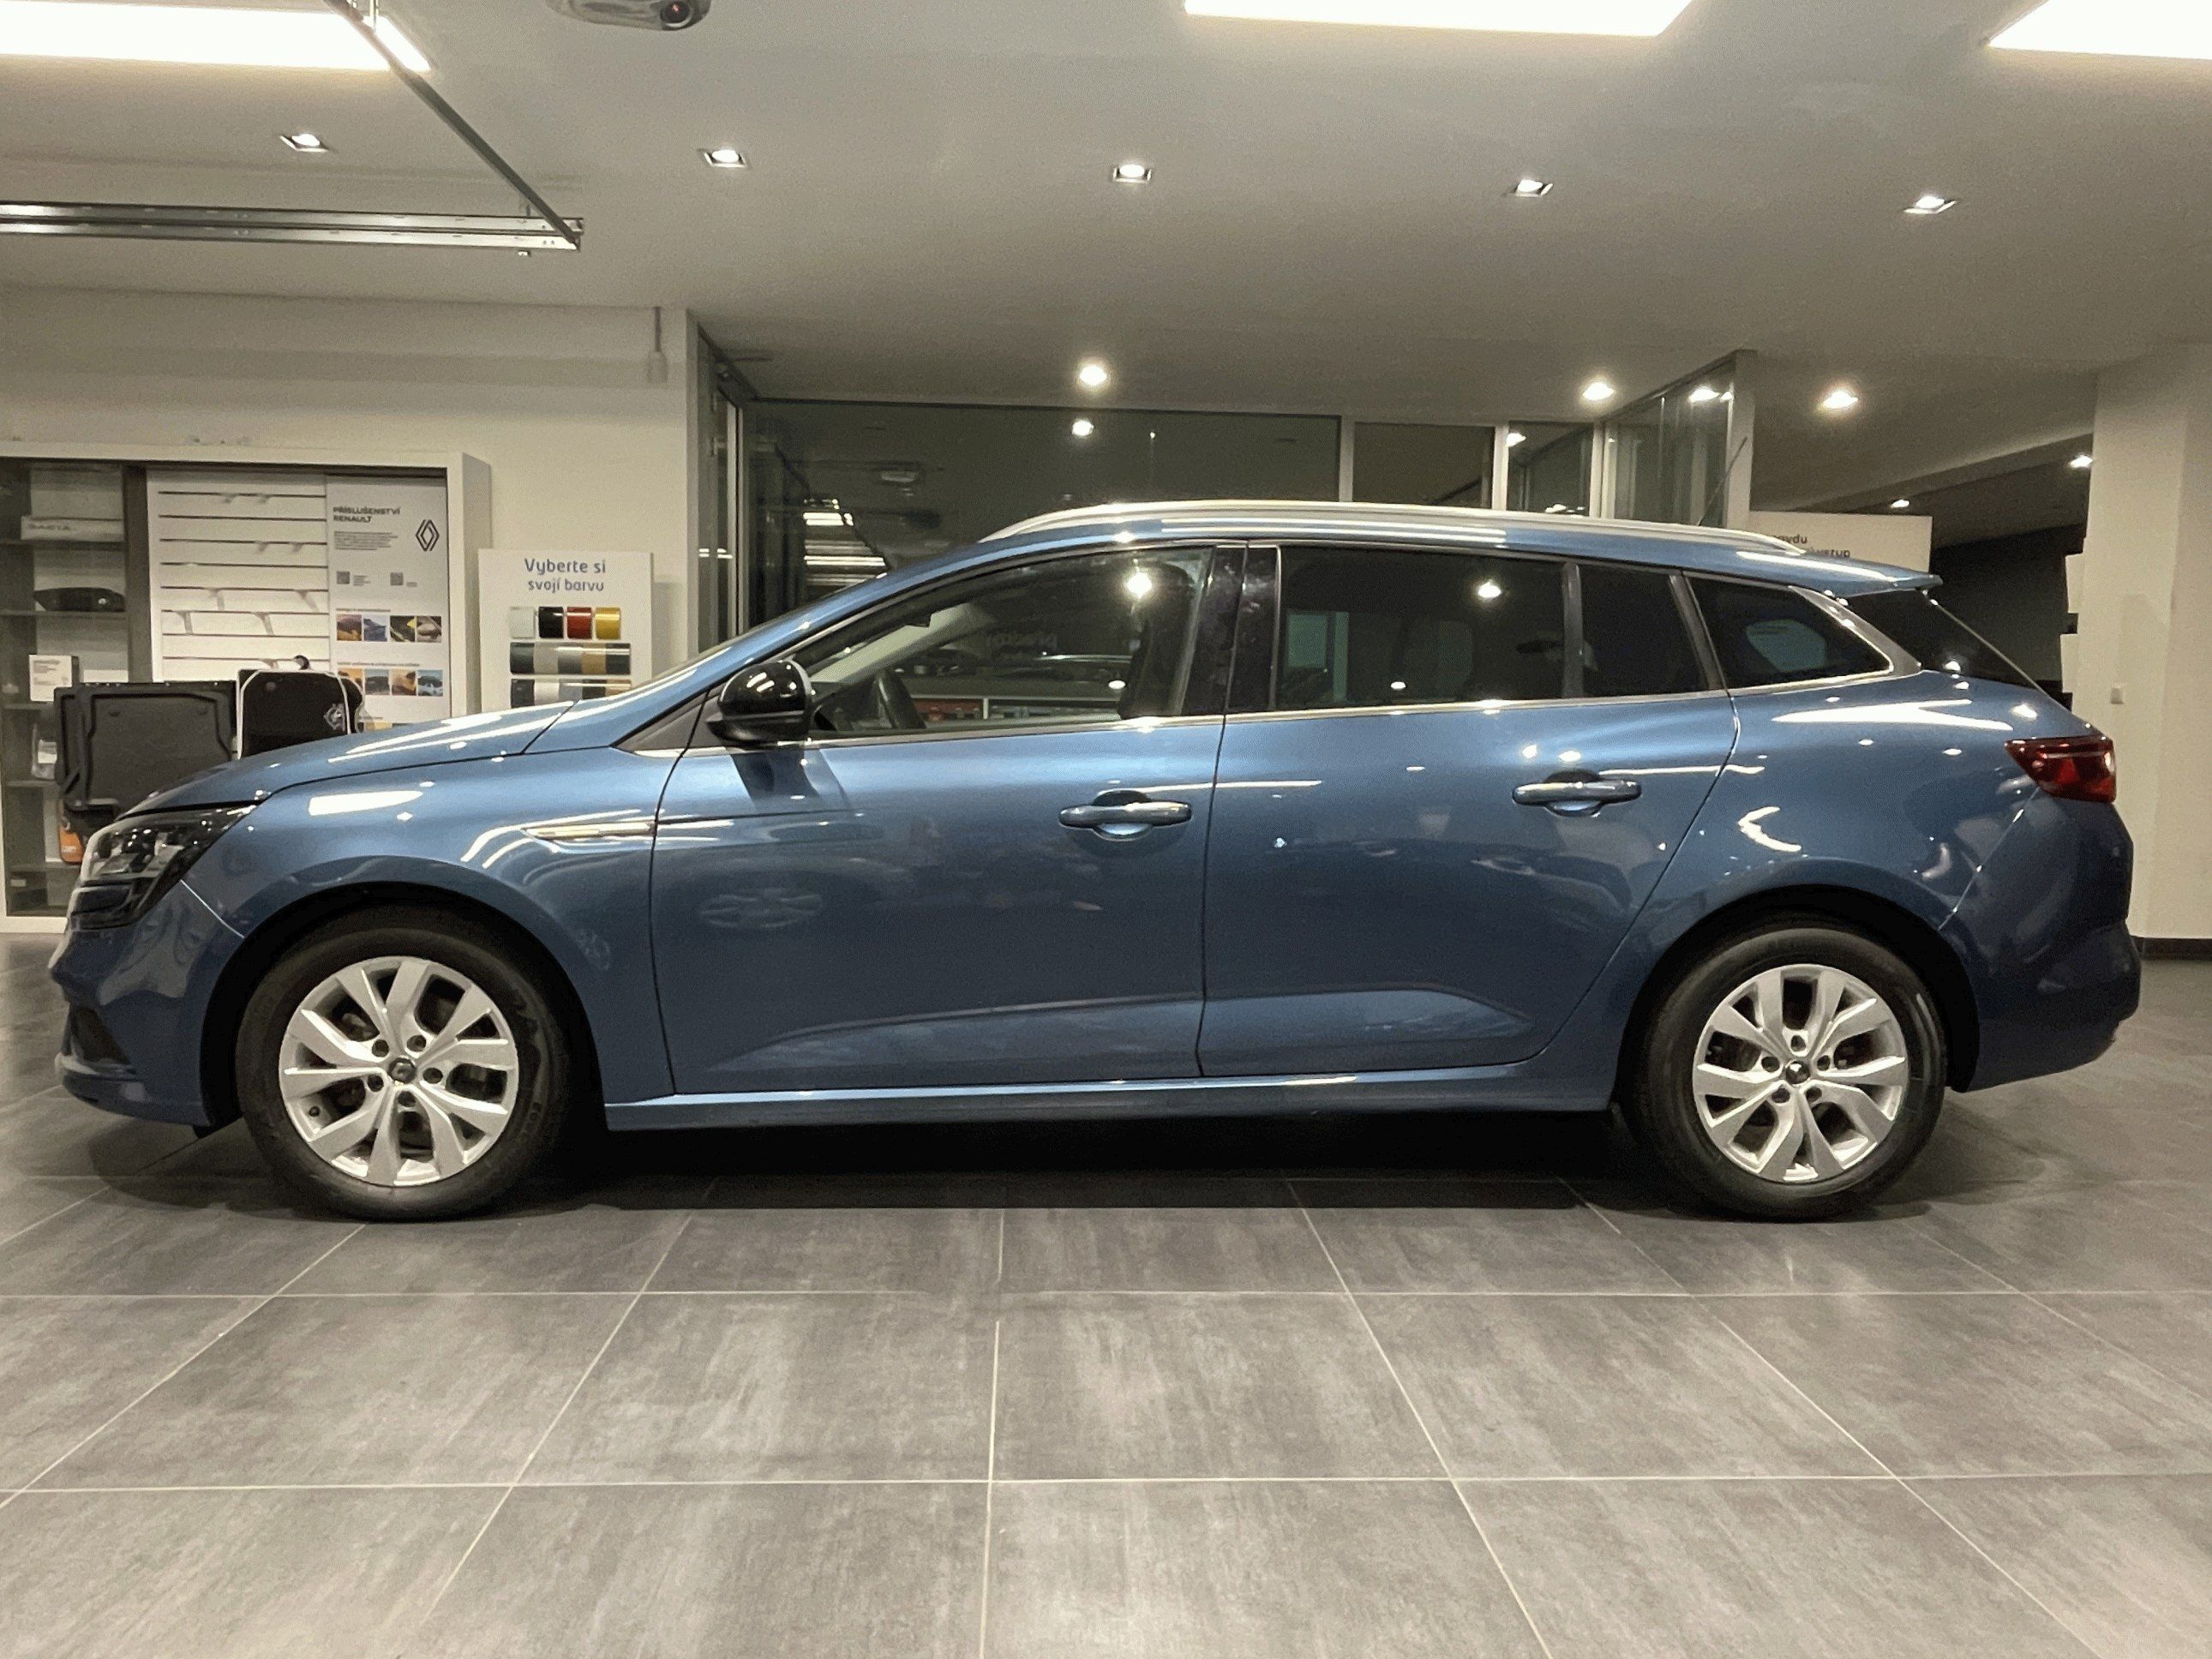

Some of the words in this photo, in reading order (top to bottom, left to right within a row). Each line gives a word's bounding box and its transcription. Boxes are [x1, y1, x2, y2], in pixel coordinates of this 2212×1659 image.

[333, 515, 372, 524] RENAULT
[525, 558, 588, 575] Vyberte
[594, 560, 606, 573] si
[565, 578, 604, 591] barvu
